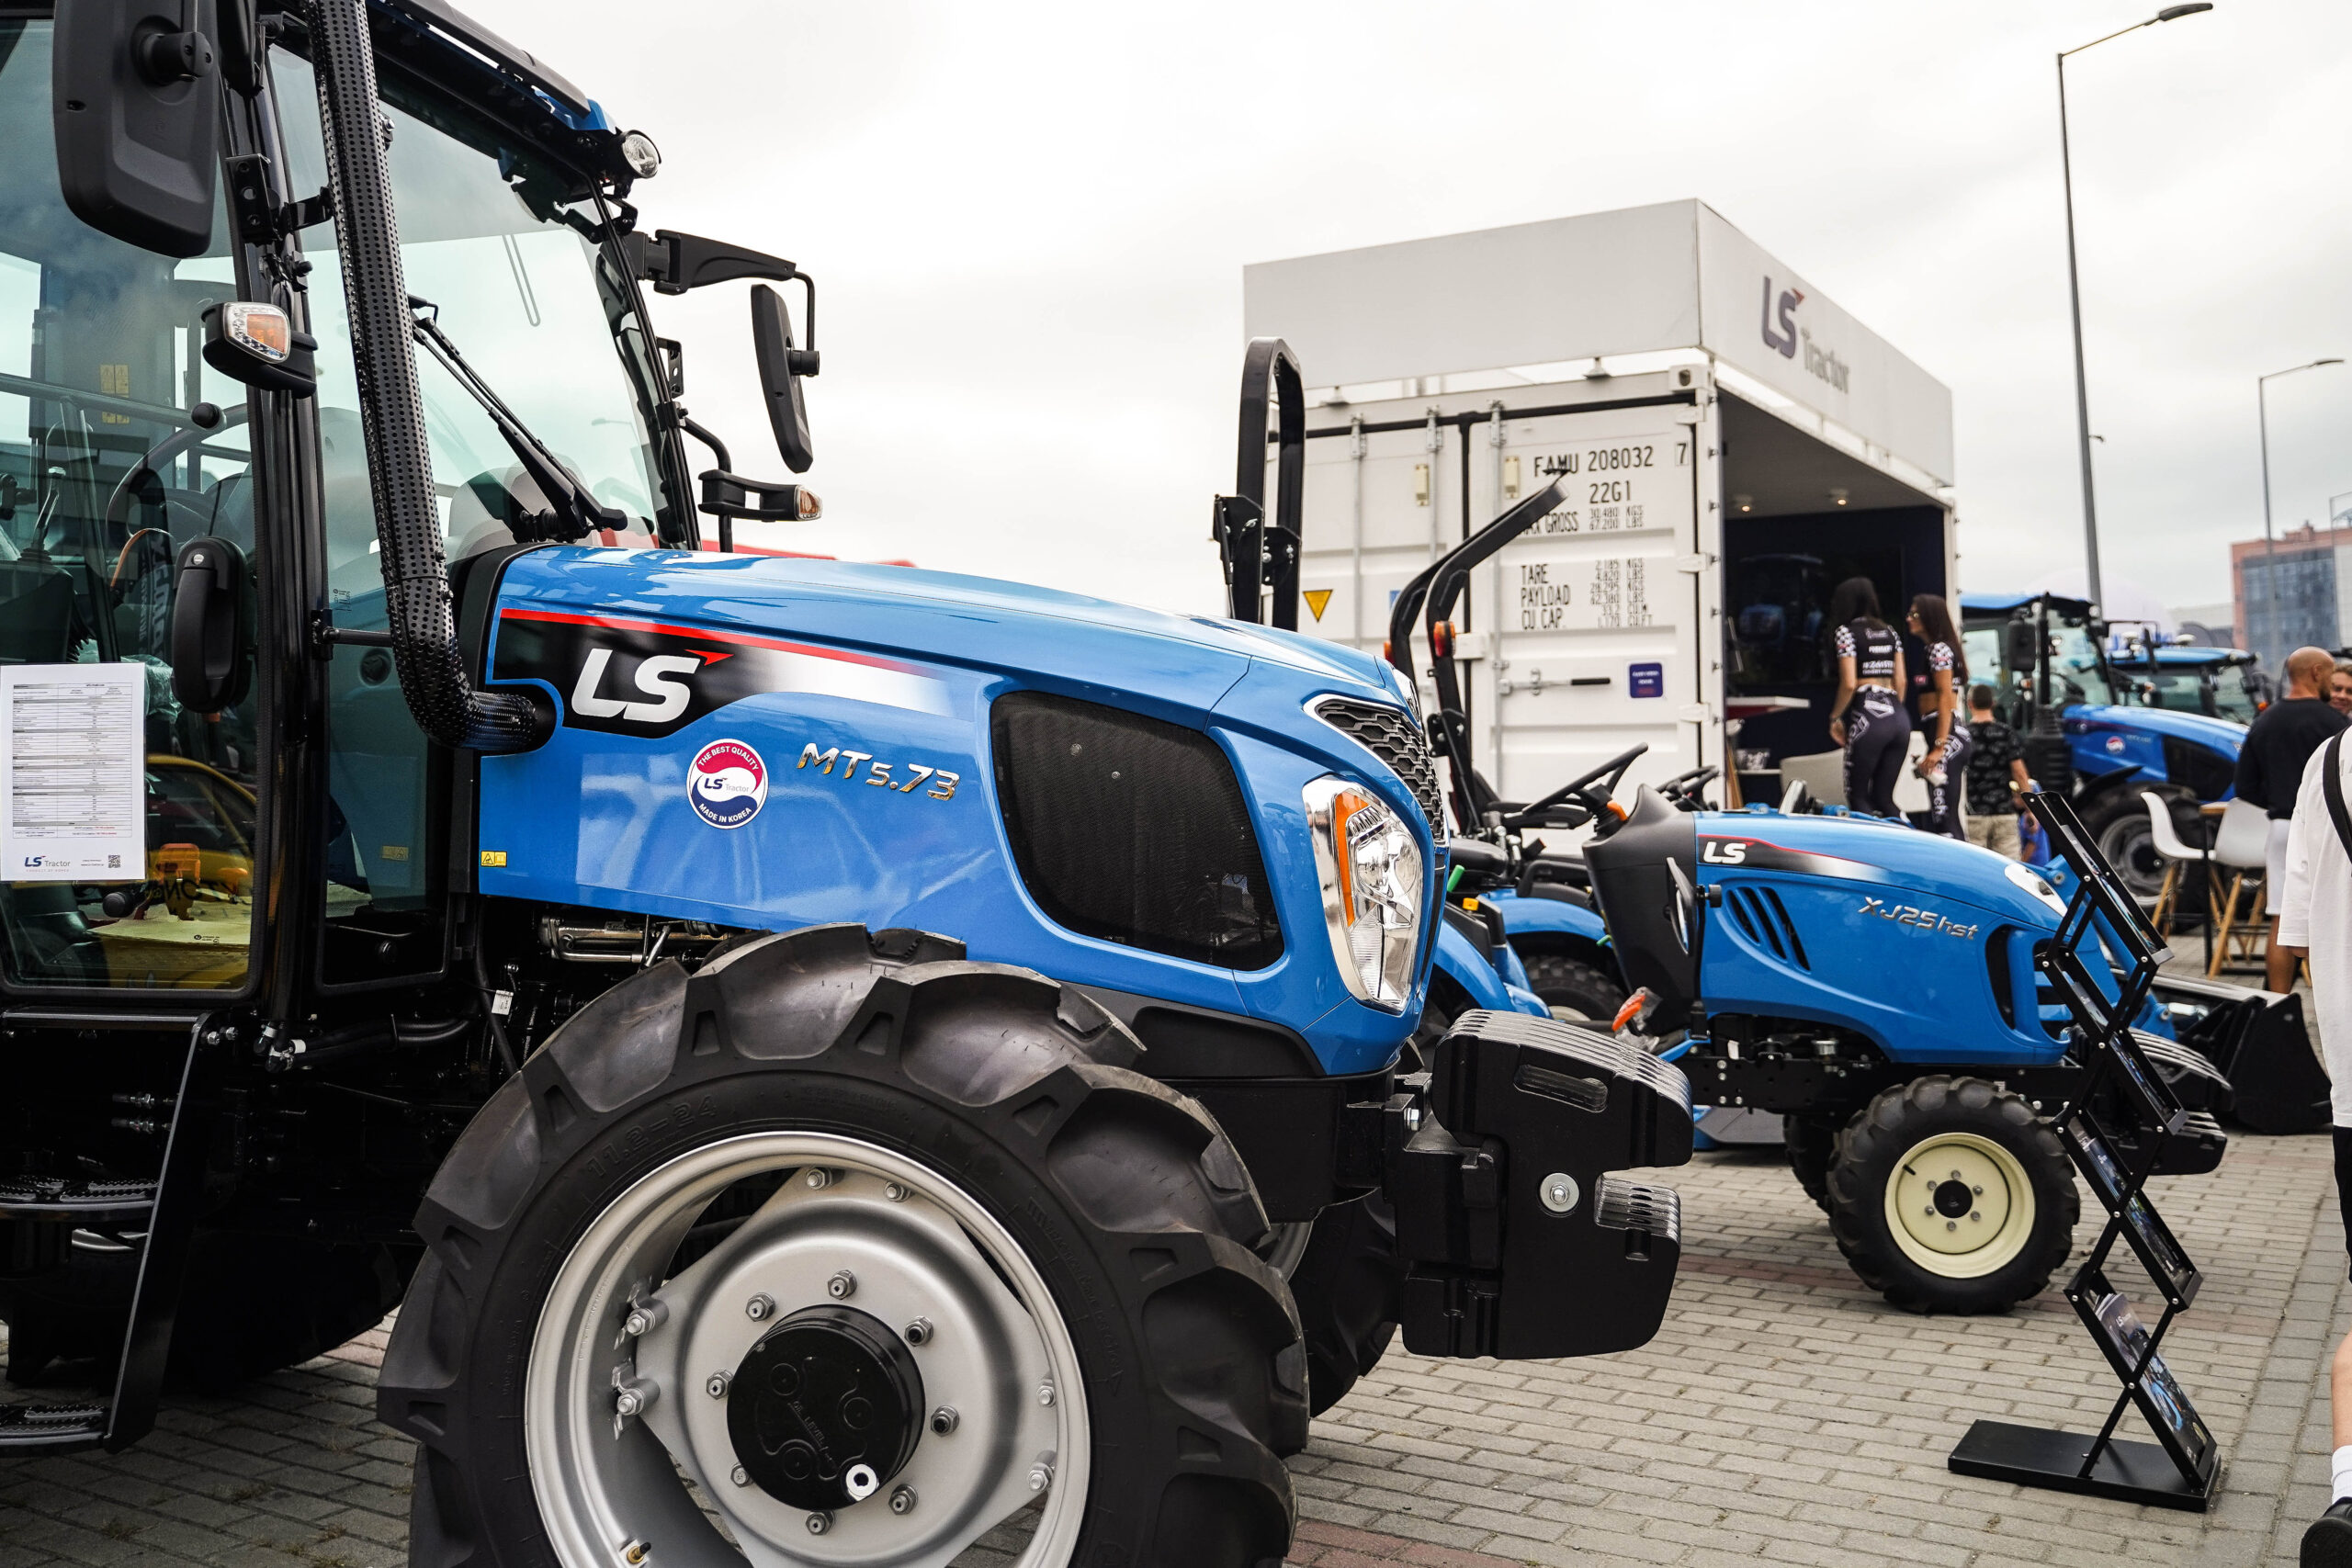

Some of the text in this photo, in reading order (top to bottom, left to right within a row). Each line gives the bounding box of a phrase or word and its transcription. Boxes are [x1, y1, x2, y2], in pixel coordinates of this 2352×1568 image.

[1761, 275, 1797, 359] LS
[1588, 446, 1654, 472] 208032
[1677, 443, 1688, 466] 7
[1589, 480, 1632, 504] 22G1
[1521, 564, 1549, 585] TARE
[1521, 584, 1571, 607] PAYLOAD
[571, 649, 701, 723] LS
[698, 746, 760, 771] THE BEST QUALITY
[797, 742, 960, 802] MT5.73
[704, 777, 750, 793] LS Tractor
[698, 803, 752, 823] MADE IN KOREA
[24, 856, 42, 867] LS
[1703, 841, 1747, 864] LS
